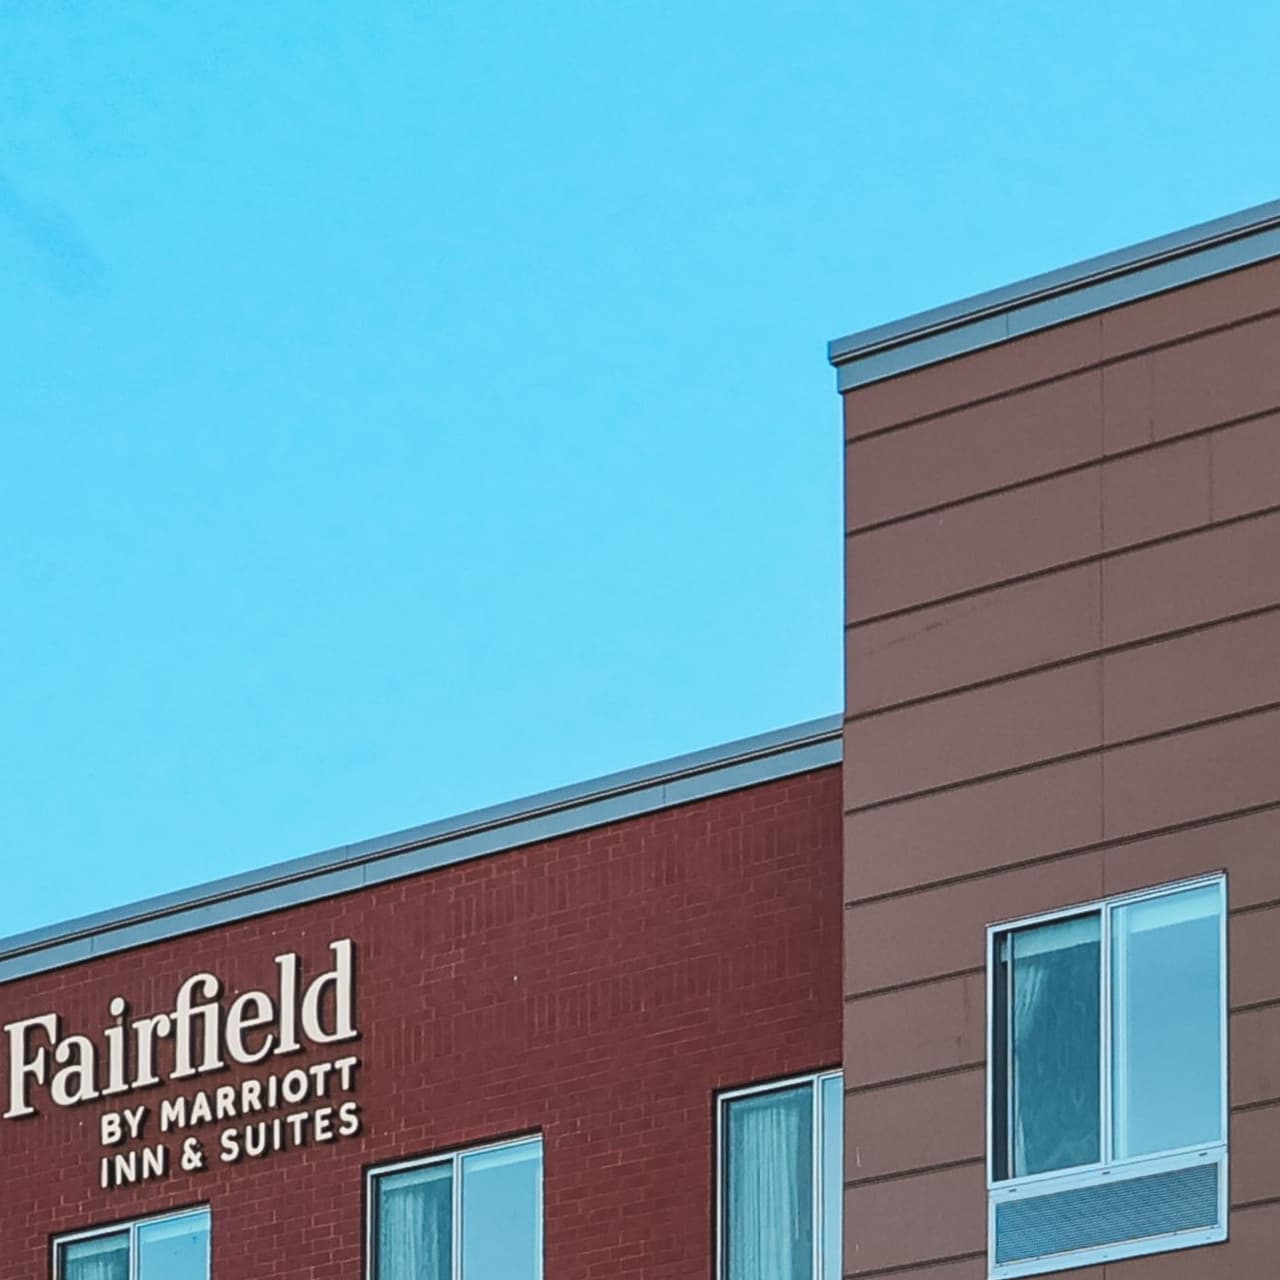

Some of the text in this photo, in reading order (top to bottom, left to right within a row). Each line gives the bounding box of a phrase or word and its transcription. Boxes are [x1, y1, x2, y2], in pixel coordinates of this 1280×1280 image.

[3, 938, 358, 1119] Fairfield
[101, 1056, 358, 1146] BY MARRIOTT
[101, 1102, 360, 1188] INN & SUITES
